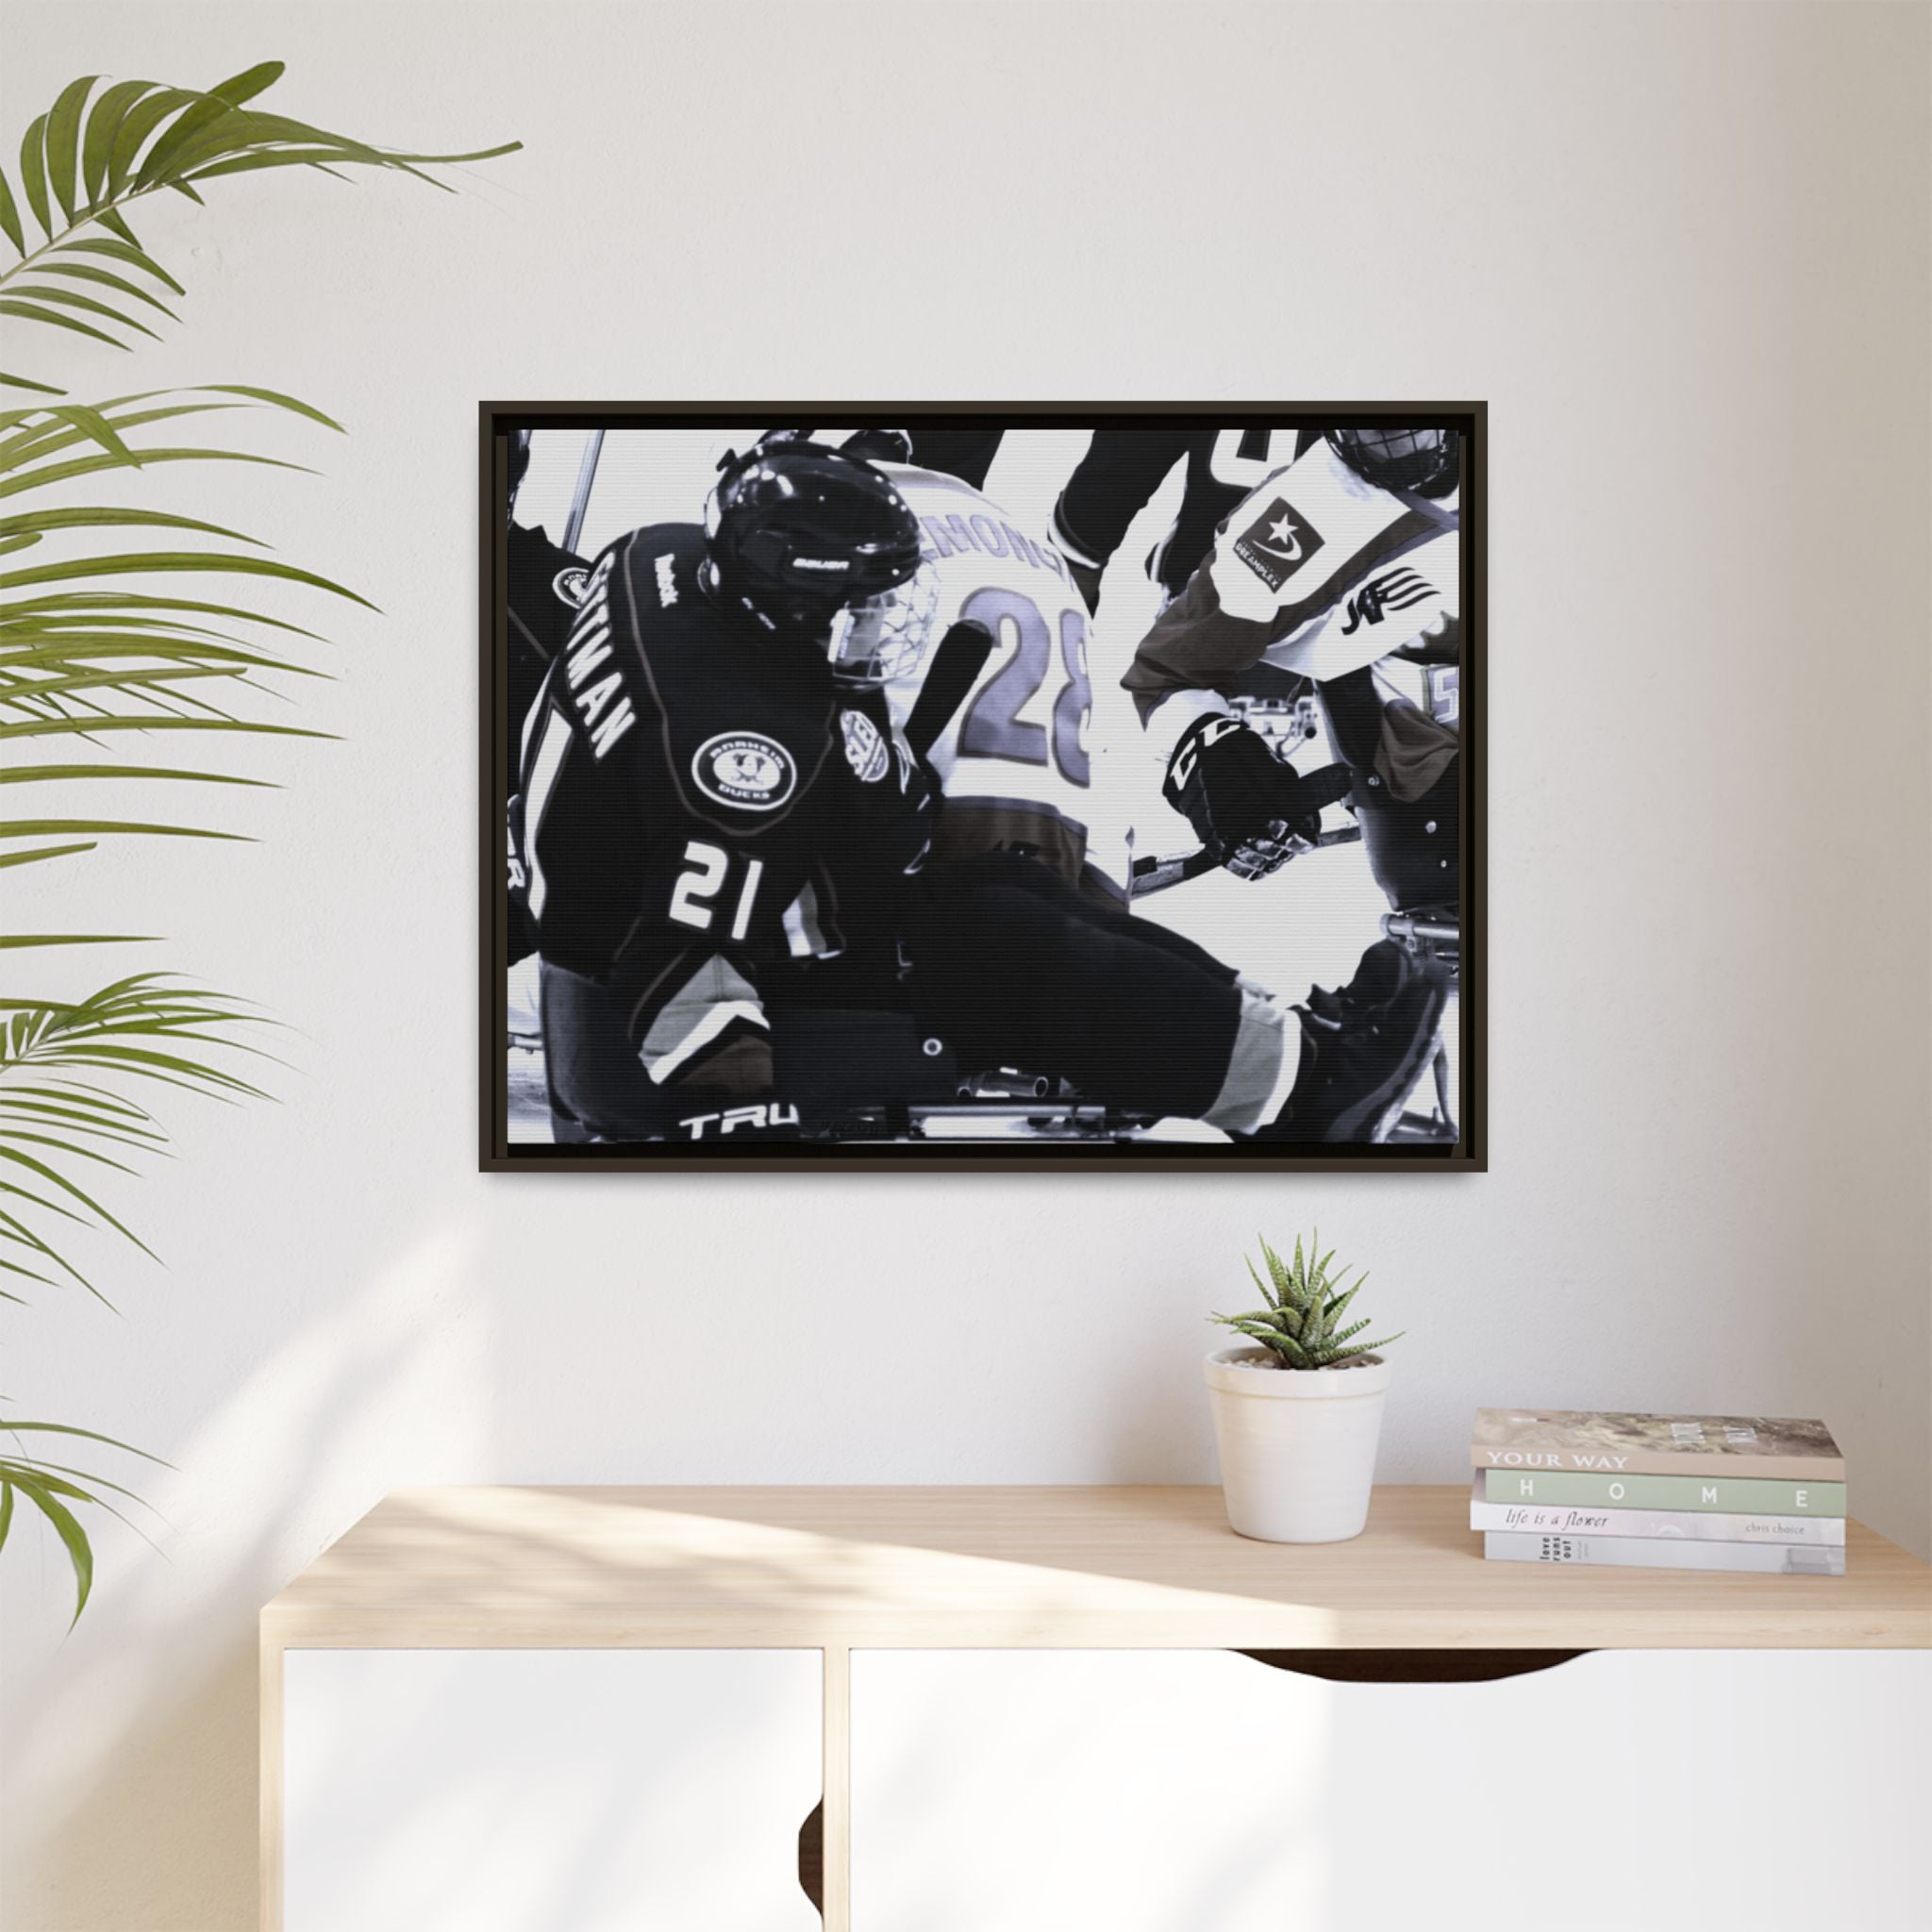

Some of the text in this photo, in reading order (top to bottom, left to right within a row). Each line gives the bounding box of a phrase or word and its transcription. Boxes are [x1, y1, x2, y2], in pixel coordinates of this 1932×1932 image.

[1235, 542, 1279, 589] DREAMPLEX
[957, 586, 1093, 790] 28
[709, 741, 785, 770] ANAHEIM
[718, 783, 771, 799] DUCKS
[669, 841, 763, 941] 21
[1487, 1451, 1629, 1470] YOUR WAY
[1506, 1508, 1608, 1531] life is a flower
[1745, 1520, 1806, 1535] chris choice
[1540, 1537, 1550, 1559] love
[1552, 1537, 1561, 1561] runs
[1561, 1540, 1572, 1559] out
